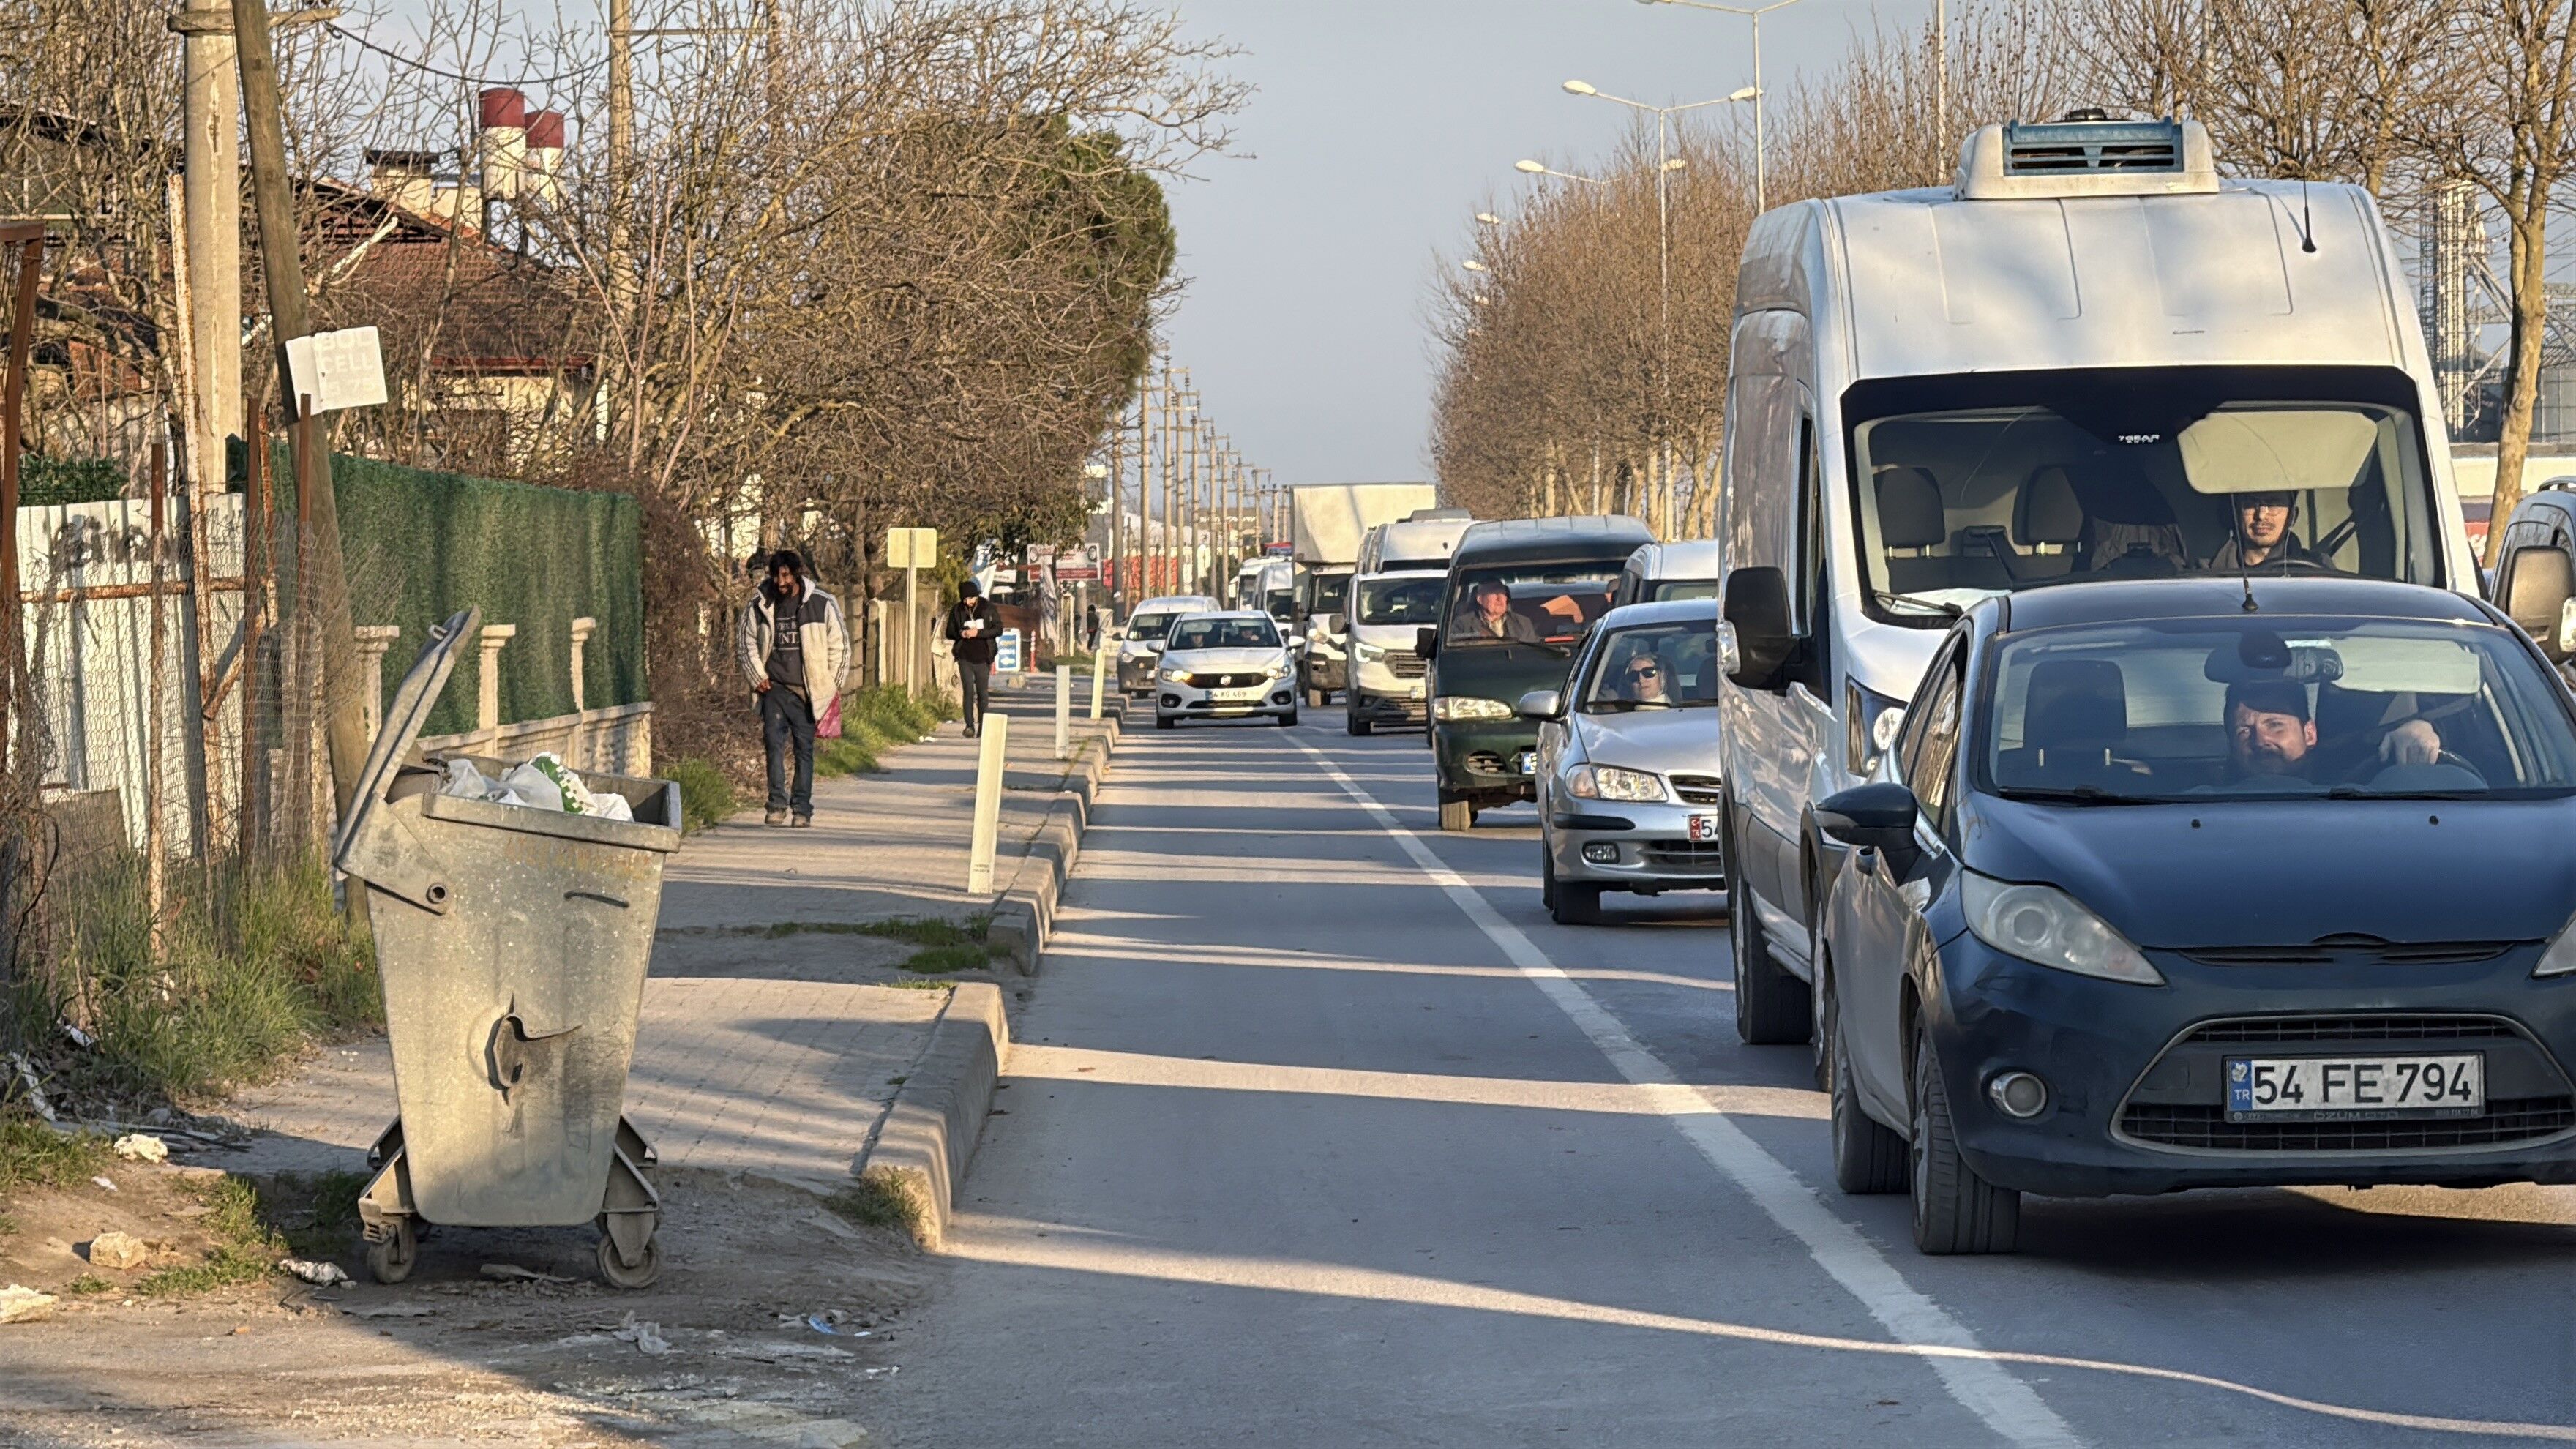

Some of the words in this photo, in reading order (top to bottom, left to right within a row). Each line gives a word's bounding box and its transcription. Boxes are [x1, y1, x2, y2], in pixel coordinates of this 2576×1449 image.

[2234, 1089, 2251, 1101] TR
[2255, 1065, 2304, 1104] 54
[2322, 1063, 2384, 1104] FE
[2397, 1062, 2472, 1102] 794
